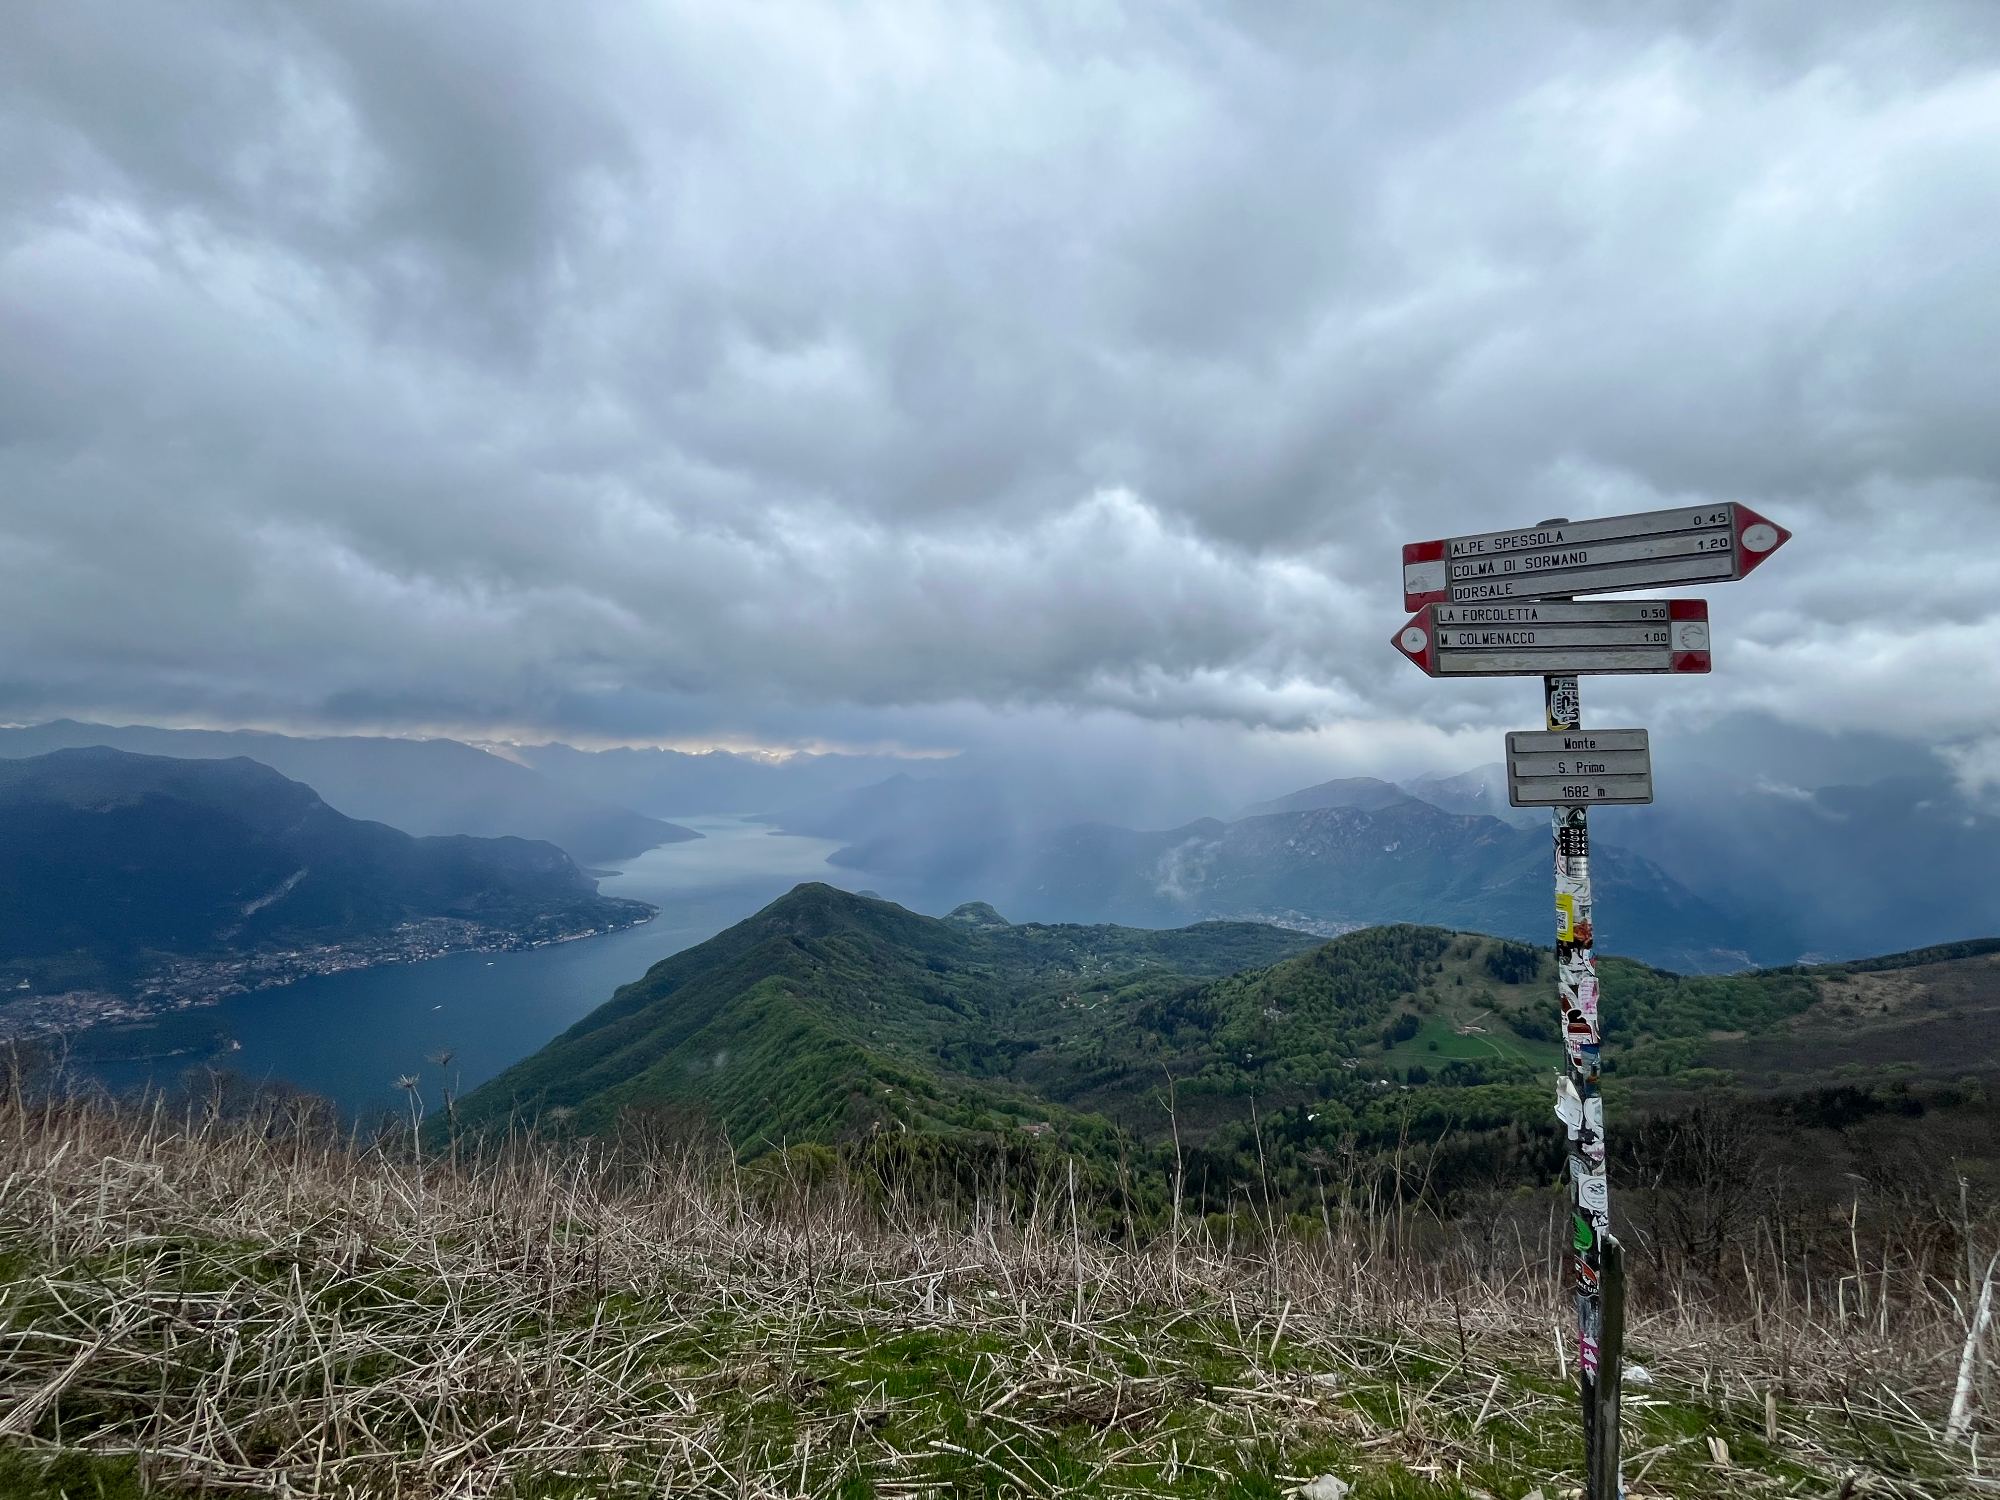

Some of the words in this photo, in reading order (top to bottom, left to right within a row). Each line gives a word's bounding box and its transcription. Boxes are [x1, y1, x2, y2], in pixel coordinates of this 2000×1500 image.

[1693, 513, 1726, 525] 0.45
[1453, 541, 1485, 555] ALPE
[1494, 531, 1563, 549] SPESSOLA
[1697, 538, 1728, 550] 1.20
[1453, 562, 1495, 577] COLMA
[1504, 560, 1516, 571] DI
[1525, 552, 1587, 569] SORMANO
[1454, 583, 1513, 599] DORSALE
[1440, 610, 1454, 621] LA
[1462, 608, 1538, 621] FORCOLETTA
[1640, 608, 1665, 619] 0.50
[1441, 633, 1452, 645] M.
[1459, 632, 1535, 645] COLMENACCO
[1644, 633, 1667, 642] 1.00
[1564, 737, 1596, 749] Monte
[1558, 762, 1569, 774] S.
[1576, 761, 1605, 773] Primo
[1562, 785, 1589, 797] 1682
[1597, 788, 1606, 797] m
